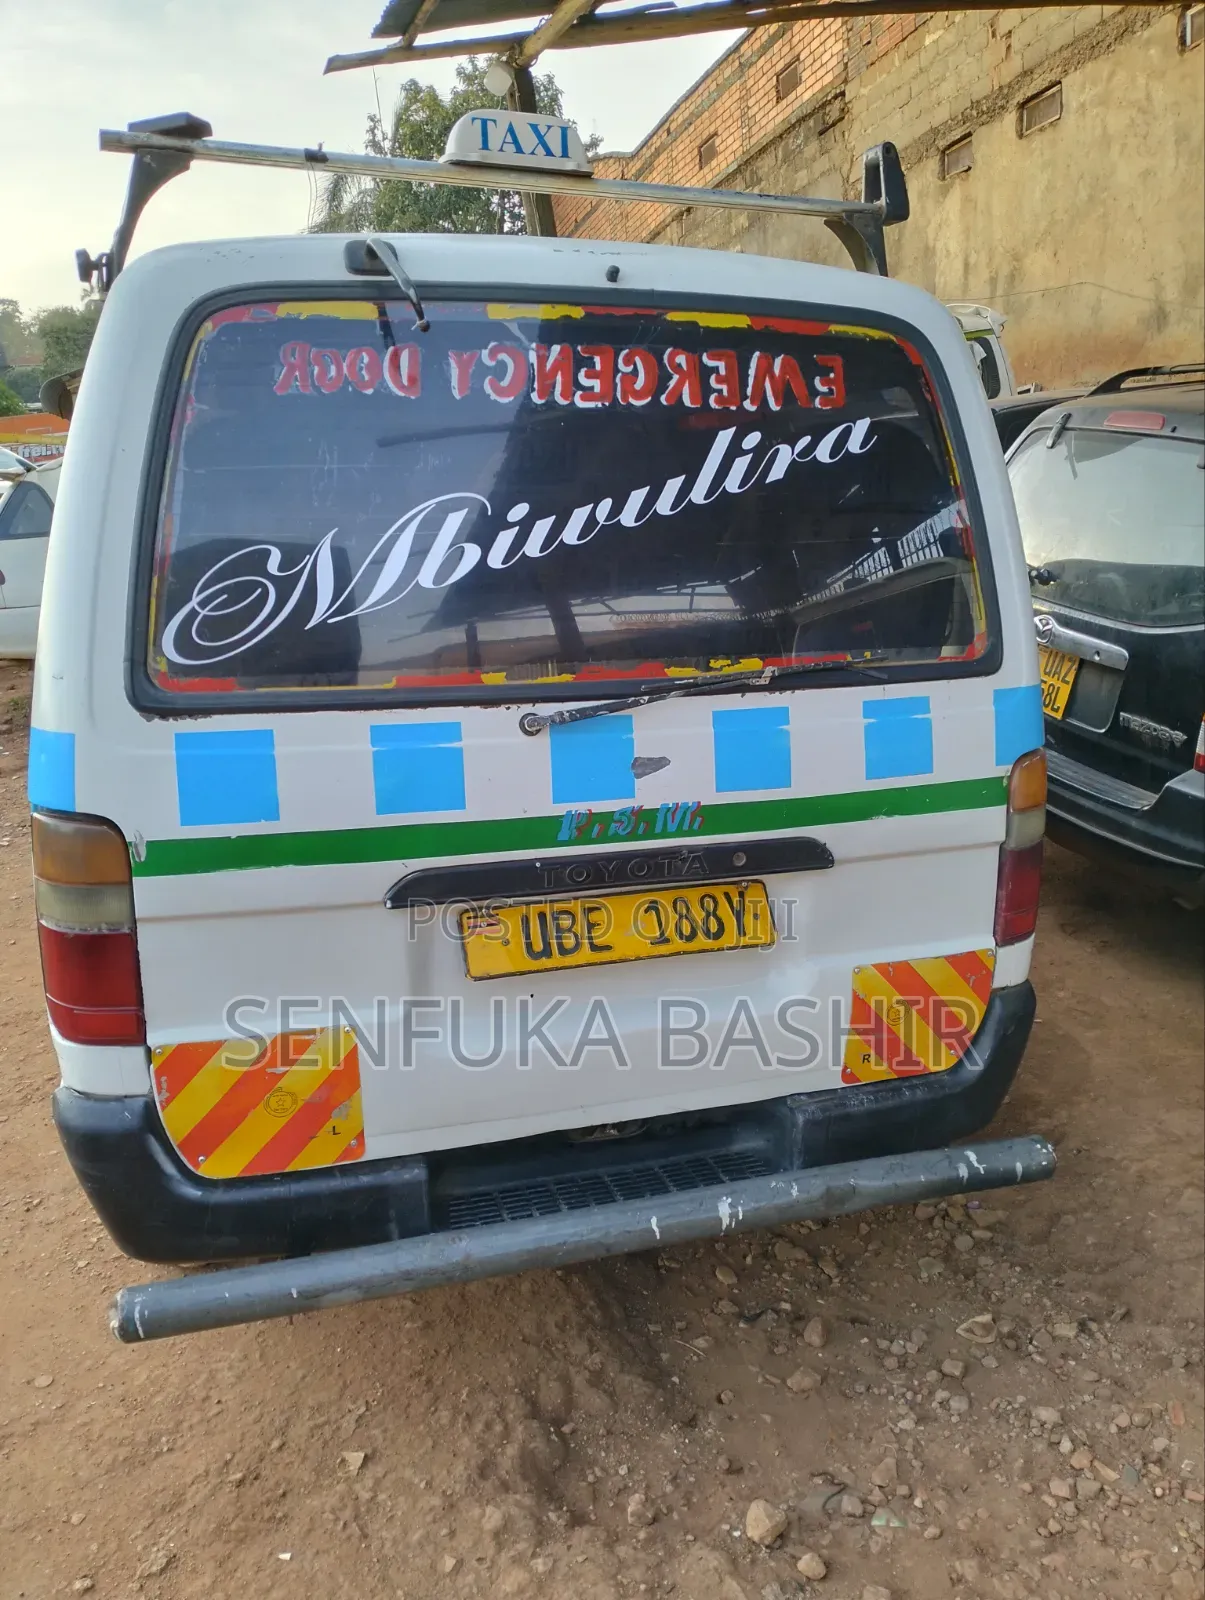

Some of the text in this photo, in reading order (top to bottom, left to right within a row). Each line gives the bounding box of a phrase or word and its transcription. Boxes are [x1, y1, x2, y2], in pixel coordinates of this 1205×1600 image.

[471, 116, 571, 159] TAXI
[540, 851, 710, 888] TOYOTA
[520, 889, 747, 961] UBE 188Y
